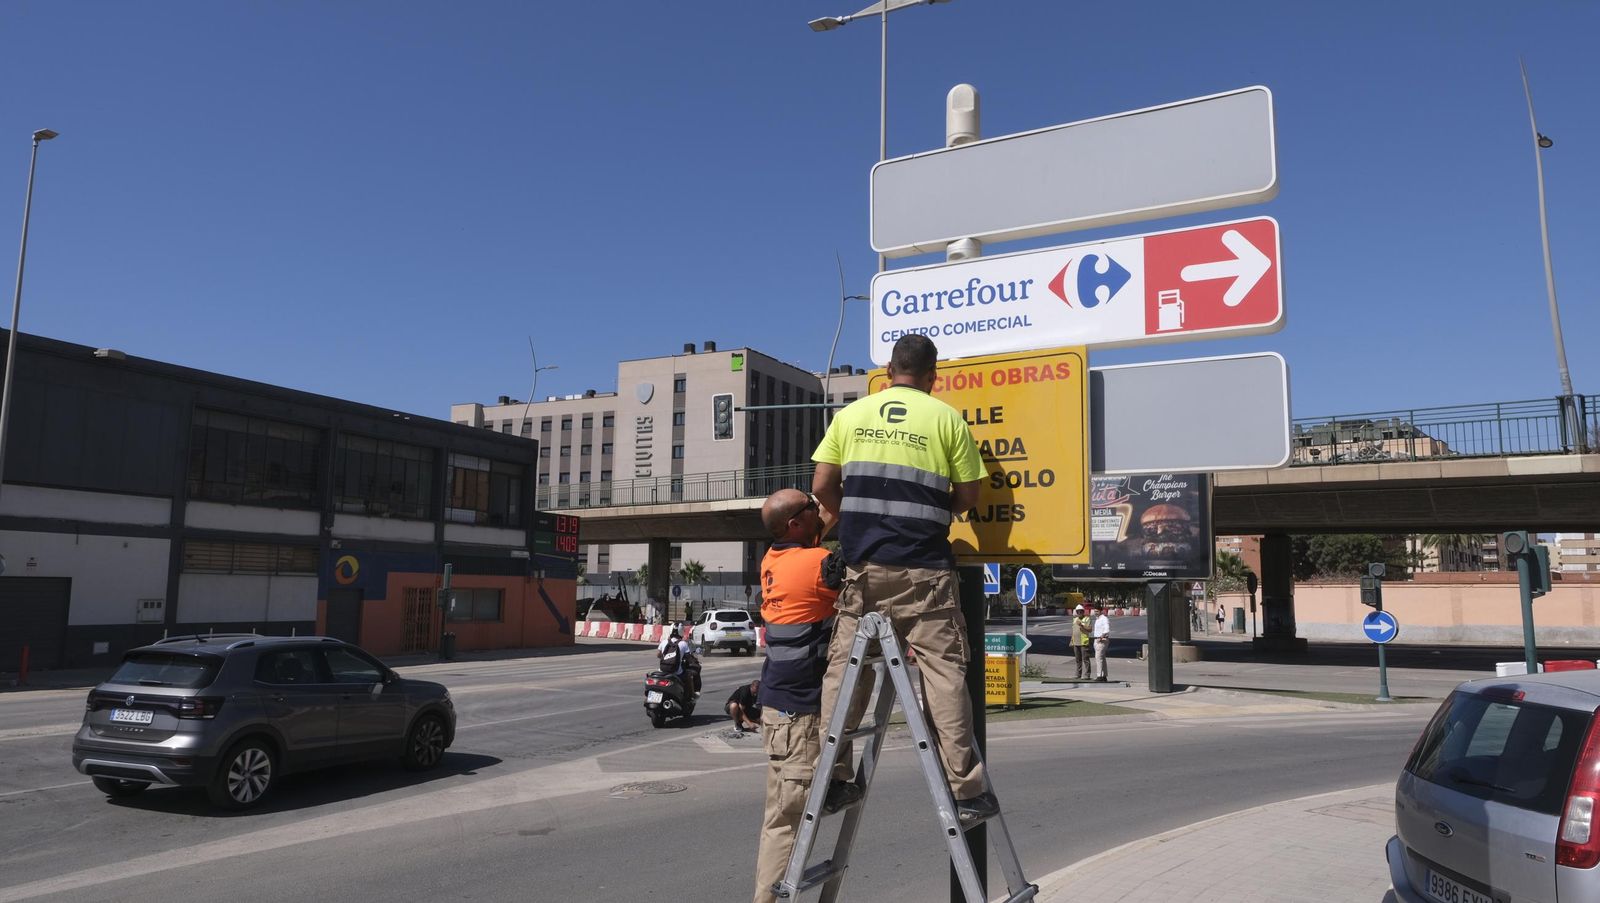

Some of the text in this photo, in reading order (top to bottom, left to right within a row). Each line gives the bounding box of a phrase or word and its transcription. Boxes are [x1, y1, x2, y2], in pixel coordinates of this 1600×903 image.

[882, 278, 1033, 316] Carrefour
[943, 314, 1032, 336] COMERCIAL
[991, 362, 1070, 386] OBRAS
[962, 406, 1004, 426] LLE
[635, 416, 654, 478] CIVITAS
[990, 469, 1055, 489] SOLO
[1143, 474, 1188, 491] The Champions
[1150, 490, 1181, 501] Burger
[1092, 508, 1112, 516] LMERÍA
[1432, 875, 1458, 903] 9386
